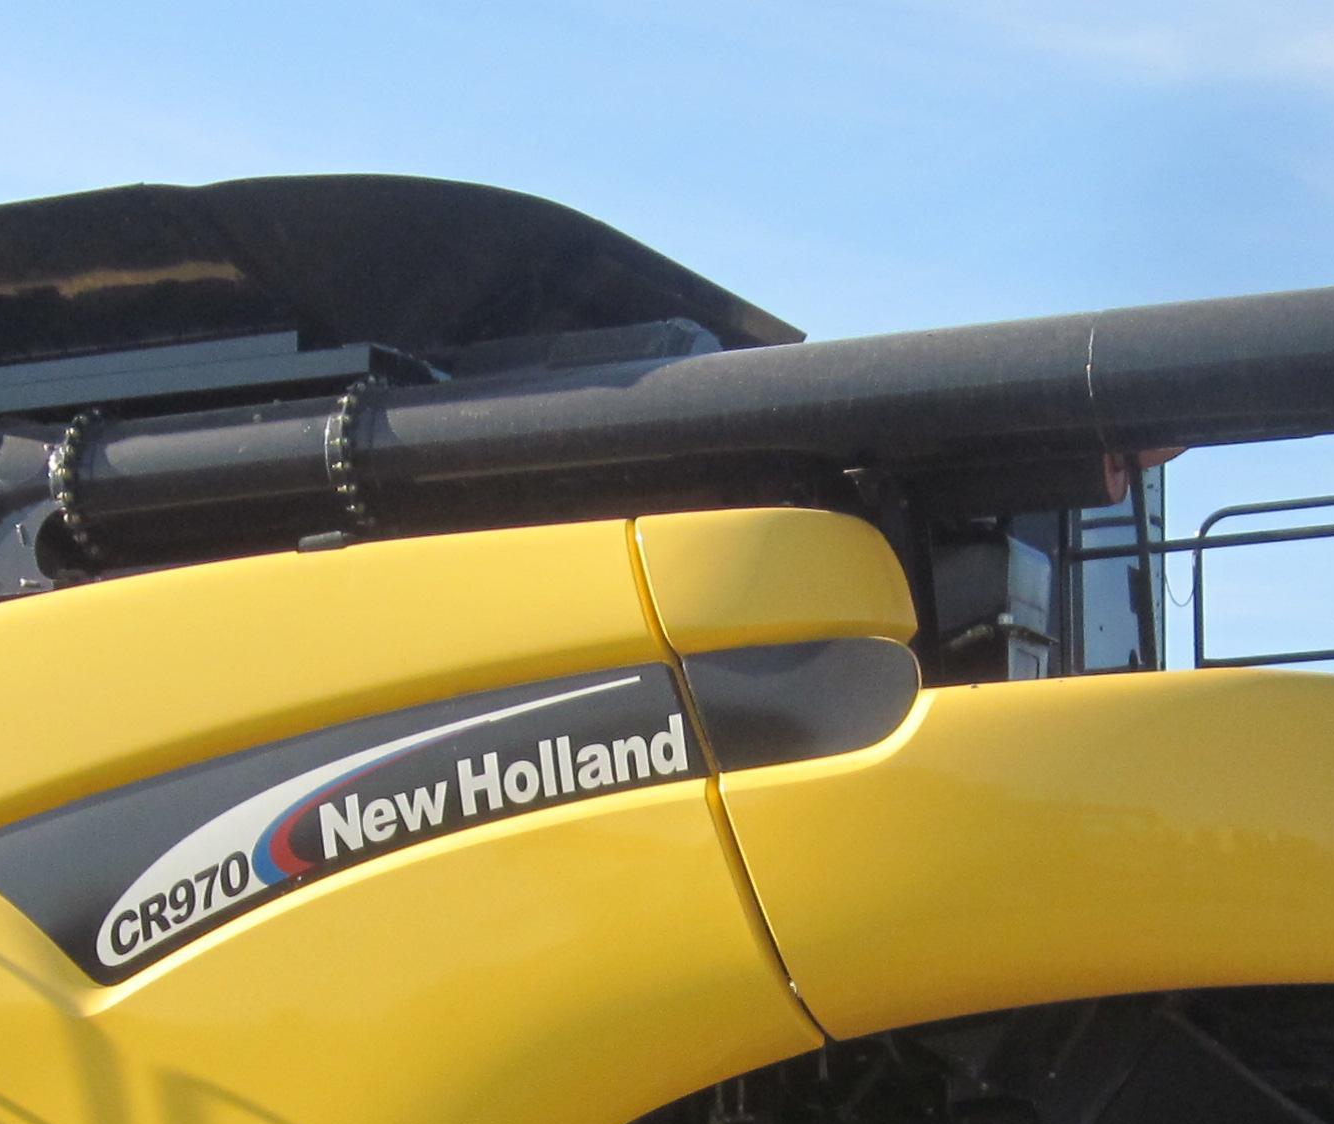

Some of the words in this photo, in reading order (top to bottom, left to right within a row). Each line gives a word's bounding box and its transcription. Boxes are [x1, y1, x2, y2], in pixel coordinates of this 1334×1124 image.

[318, 780, 448, 860] New
[457, 712, 689, 817] Holland
[110, 850, 250, 956] CR970
